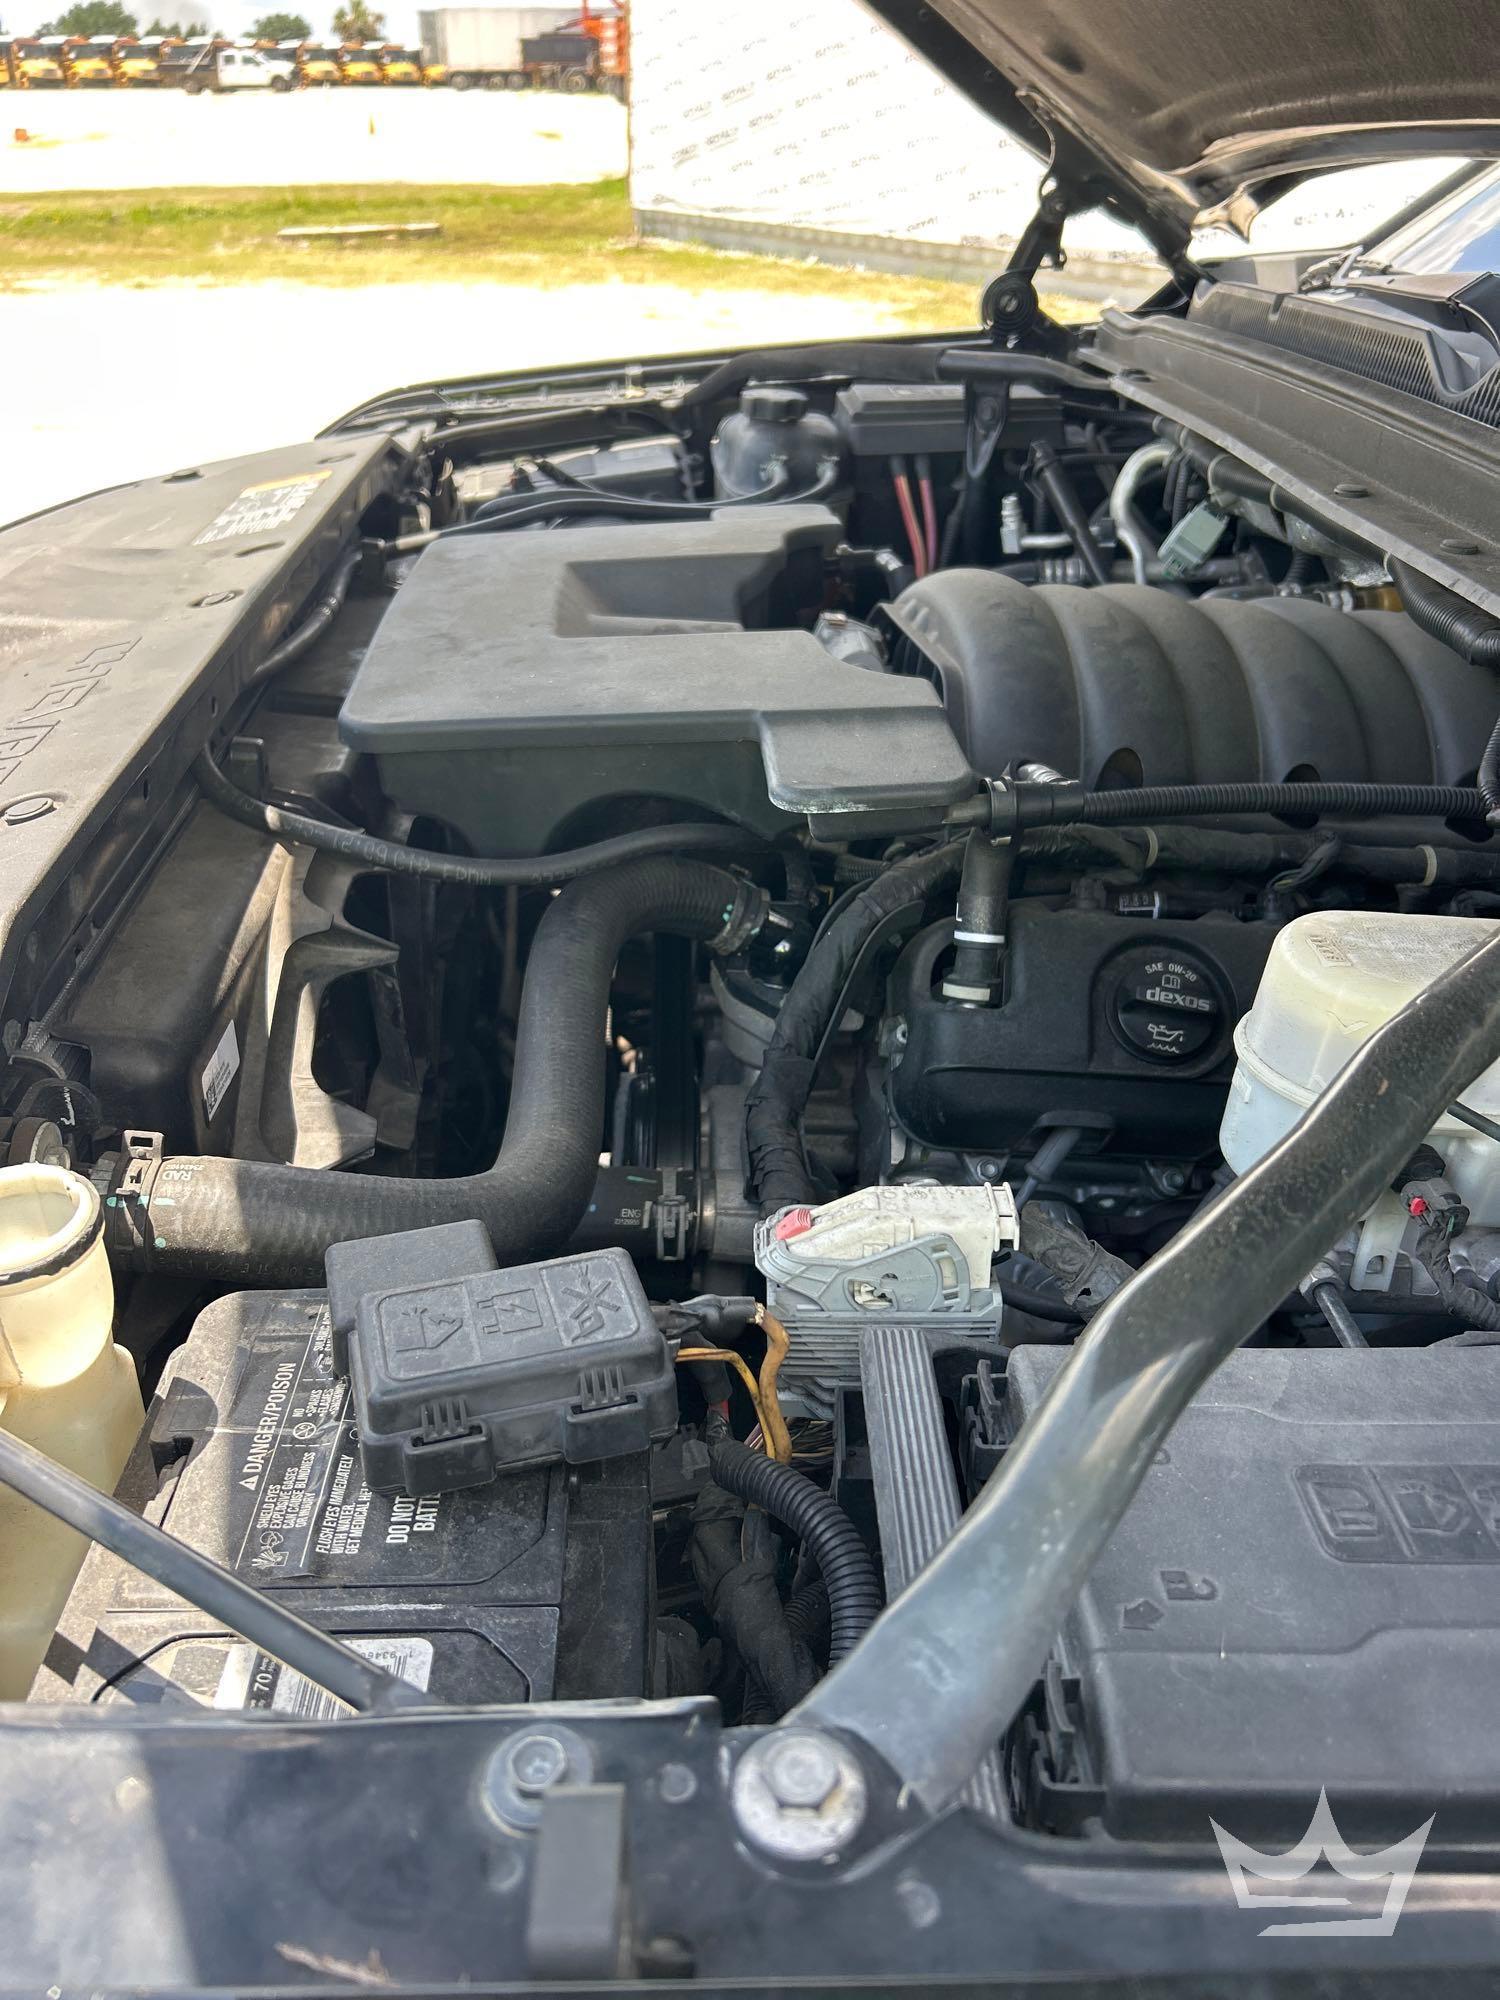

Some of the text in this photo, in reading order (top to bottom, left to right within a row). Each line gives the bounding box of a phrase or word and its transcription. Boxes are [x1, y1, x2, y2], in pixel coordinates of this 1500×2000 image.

[1145, 962, 1197, 982] SAE 0W-20
[1146, 987, 1210, 1012] dexos
[162, 1170, 192, 1181] RAD
[621, 1208, 641, 1218] ENG
[243, 1363, 297, 1473] DANGER/POISON
[292, 1408, 305, 1417] NO
[270, 1467, 298, 1528] EXPLOSIVE GASES
[283, 1452, 316, 1528] CAN CAUSE BLINDNESS
[315, 1454, 354, 1554] FLUSH EYES IMMEDIATELY
[257, 1484, 280, 1528] SHIELD EYES
[295, 1492, 316, 1528] OR INJURY
[349, 1502, 370, 1537] MEDICAL
[386, 1496, 416, 1543] DO NOT
[330, 1534, 348, 1554] WITH
[345, 1539, 360, 1554] GET
[253, 1673, 273, 1692] 70
